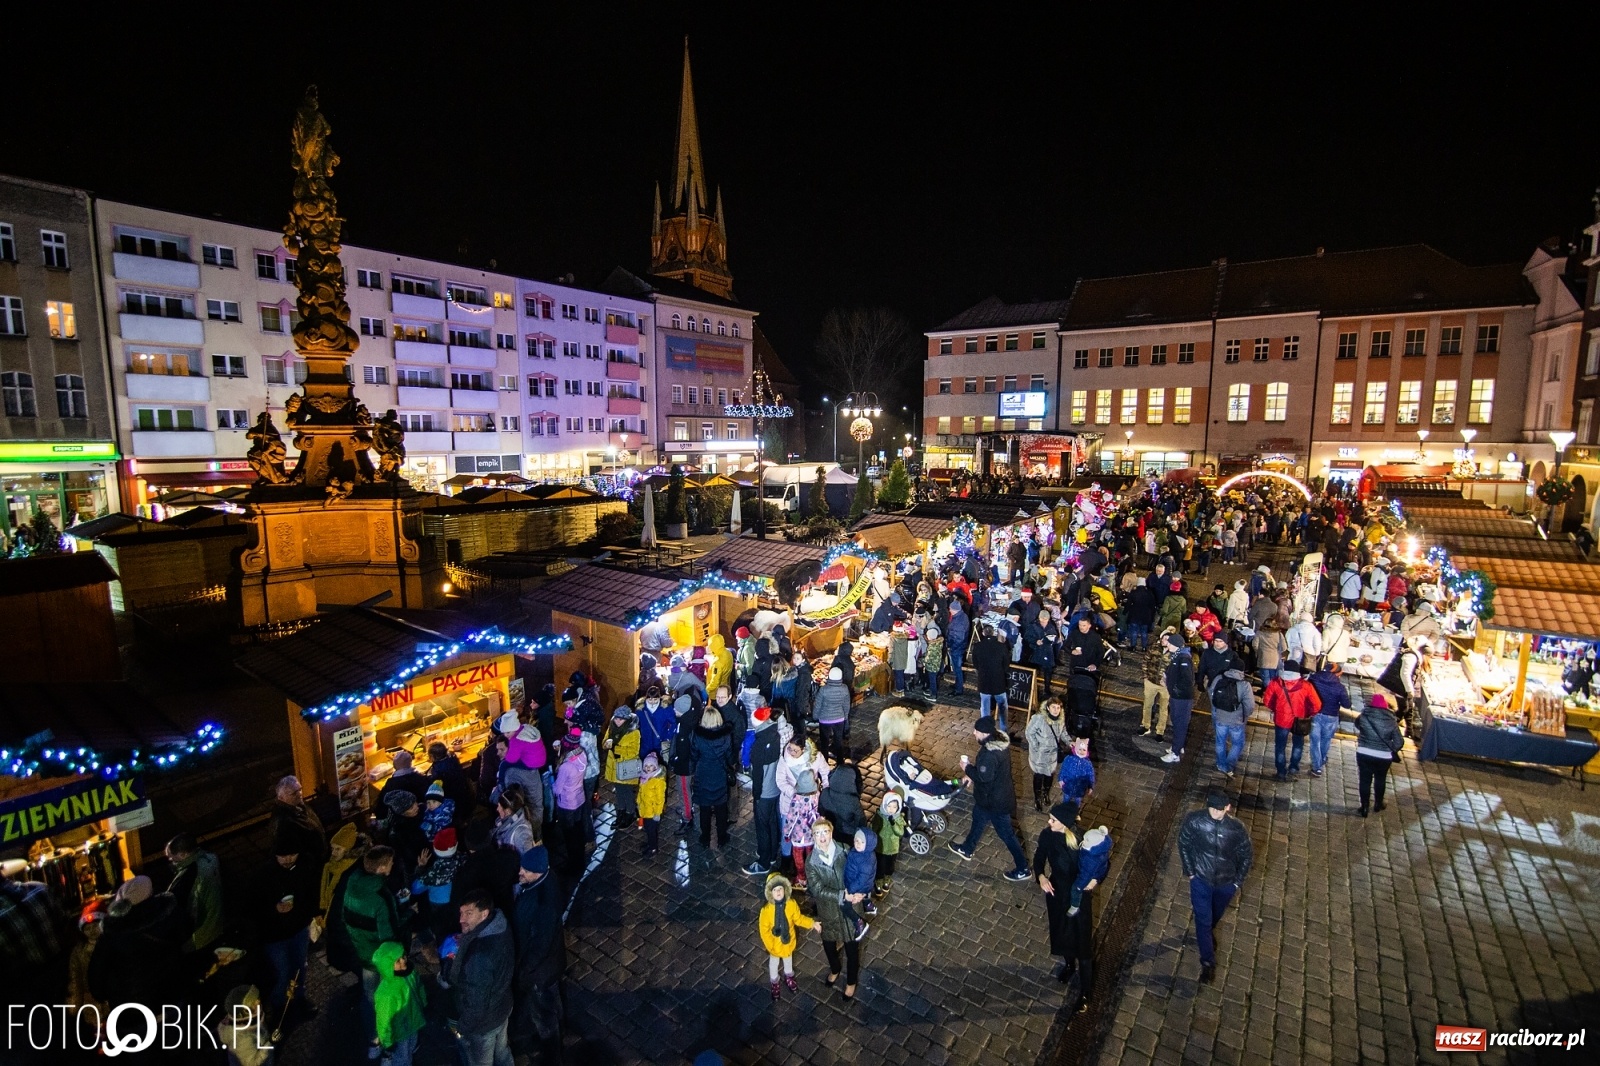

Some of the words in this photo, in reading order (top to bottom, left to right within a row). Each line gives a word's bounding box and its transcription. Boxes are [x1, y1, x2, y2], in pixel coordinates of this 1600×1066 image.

[478, 458, 499, 467] empik
[371, 684, 414, 712] MINI
[432, 661, 499, 695] PĄCZKI
[0, 777, 140, 842] ZIEMNIAK
